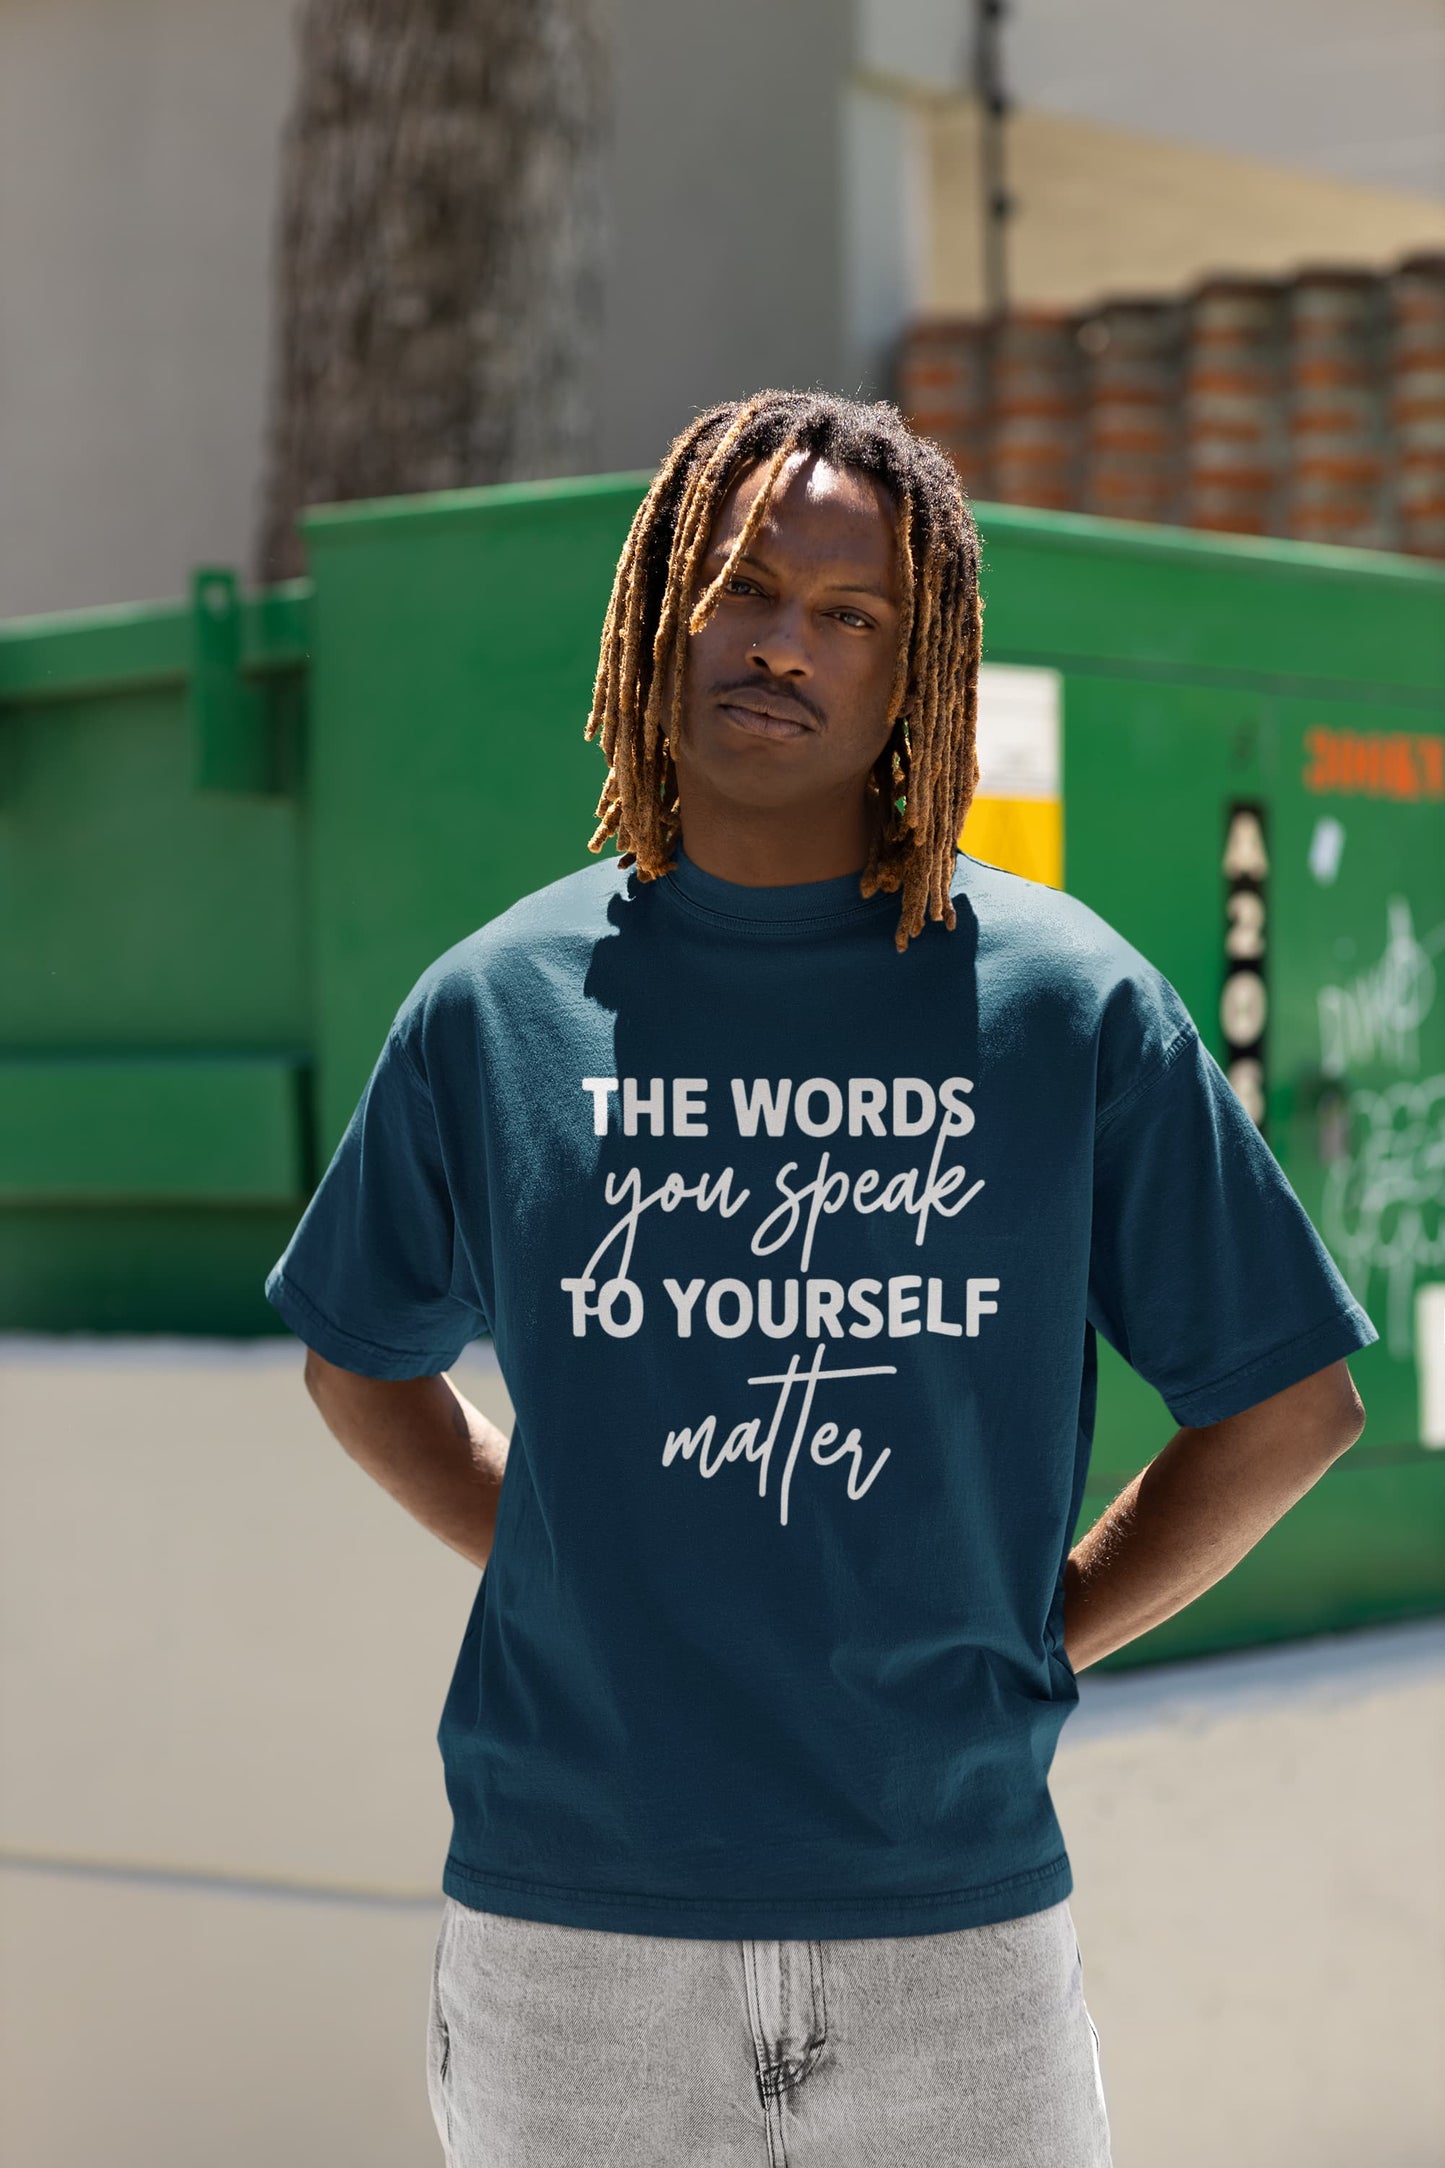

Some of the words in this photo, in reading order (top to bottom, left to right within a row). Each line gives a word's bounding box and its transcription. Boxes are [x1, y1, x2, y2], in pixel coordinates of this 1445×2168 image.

[582, 1077, 708, 1137] THE
[731, 1077, 975, 1137] WORDS
[581, 1168, 750, 1316] you
[751, 1110, 985, 1272] speak
[561, 1279, 644, 1338] TO
[663, 1275, 1000, 1339] YOURSELF
[662, 1343, 897, 1526] matter
